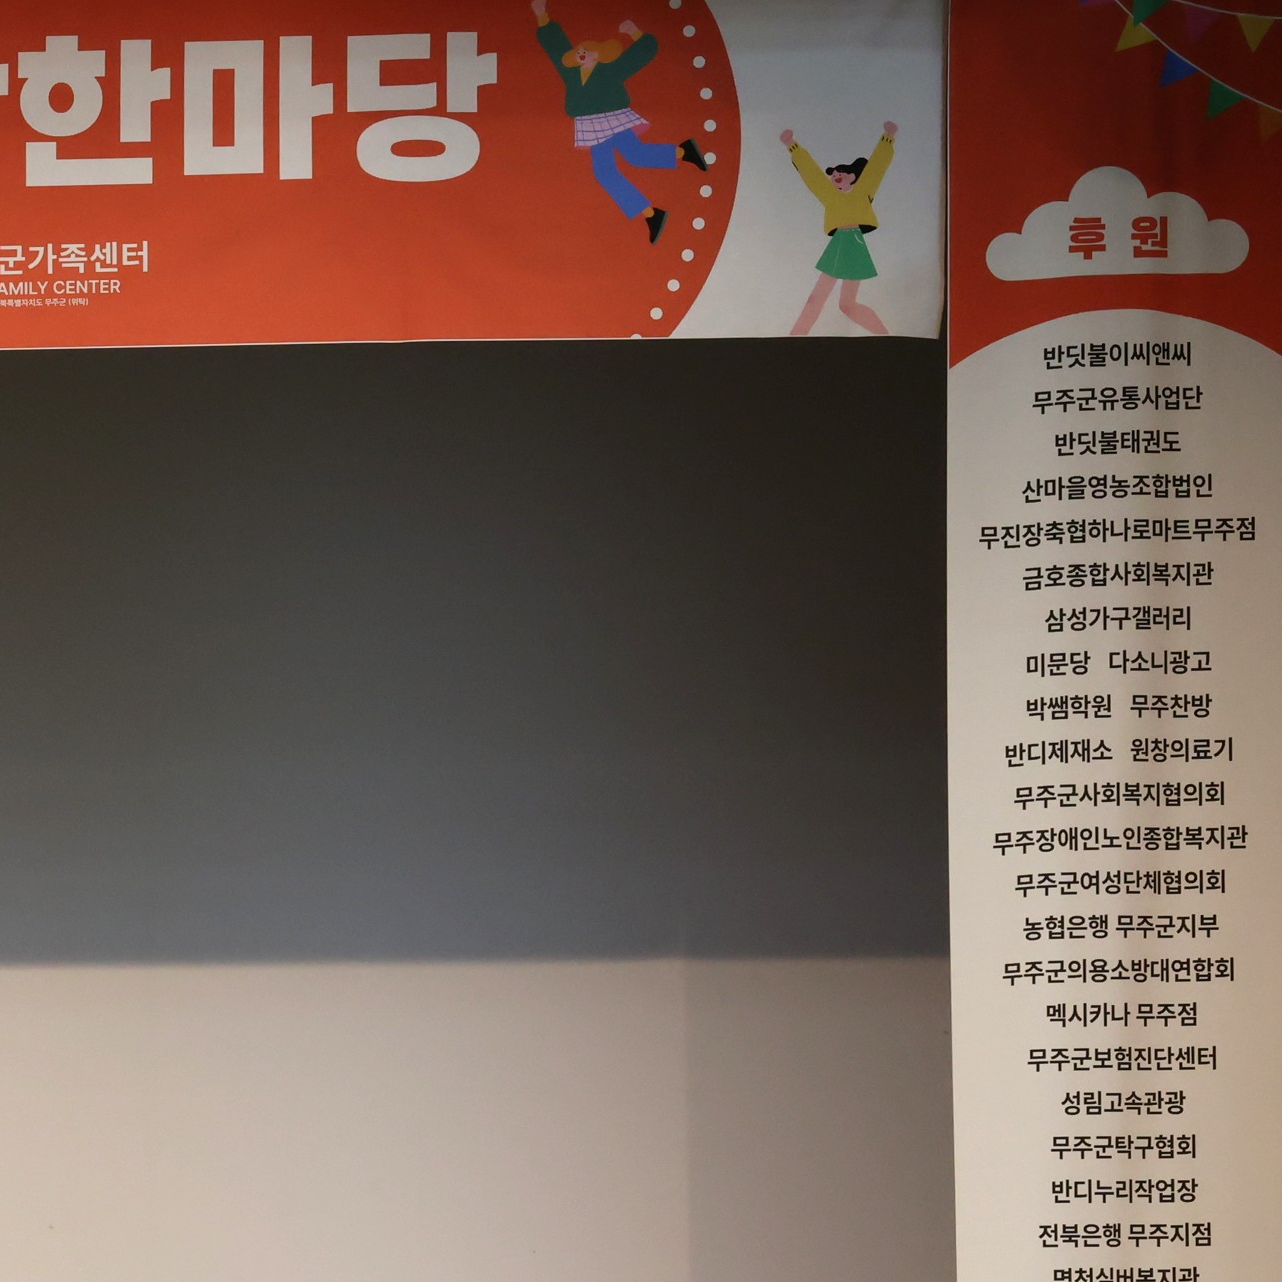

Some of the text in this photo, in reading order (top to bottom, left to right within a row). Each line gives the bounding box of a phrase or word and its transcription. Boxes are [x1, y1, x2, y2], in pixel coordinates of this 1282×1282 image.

[53, 279, 121, 295] CENTER
[1043, 340, 1192, 370] 반딧불이씨앤씨
[1032, 385, 1204, 415] 무주군유통사업단
[1055, 429, 1182, 457] 반딧불태권도
[1021, 473, 1213, 504] 산마을영농조합법인
[978, 516, 1256, 550] 무진장축협하나로마트무주점
[1022, 561, 1215, 592] 금호종합사회복지관
[1044, 605, 1191, 633] 삼성가구갤러리
[1026, 649, 1212, 678] 미문당 다소니광고
[1026, 693, 1213, 722] 박쌤학원 무주찬방
[1005, 736, 1233, 768] 반디제재소 원창의료기
[1013, 780, 1225, 811] 무주군사회복지협의회
[992, 824, 1249, 856] 무주장애인노인종합복지관
[1014, 868, 1226, 898] 무주군여성단체협의회
[1022, 913, 1220, 941] 농협은행 무주군지부
[1002, 956, 1235, 987] 무주군의용소방대연합회
[1046, 1001, 1197, 1028] 멕시카나 무주점
[1027, 1045, 1217, 1073] 무주군보험진단센터
[1061, 1090, 1187, 1116] 성림고속관광
[1050, 1133, 1196, 1160] 무주군탁구협회
[1051, 1178, 1199, 1204] 반디누리작업장
[1038, 1221, 1212, 1248] 전북은행 무주지점
